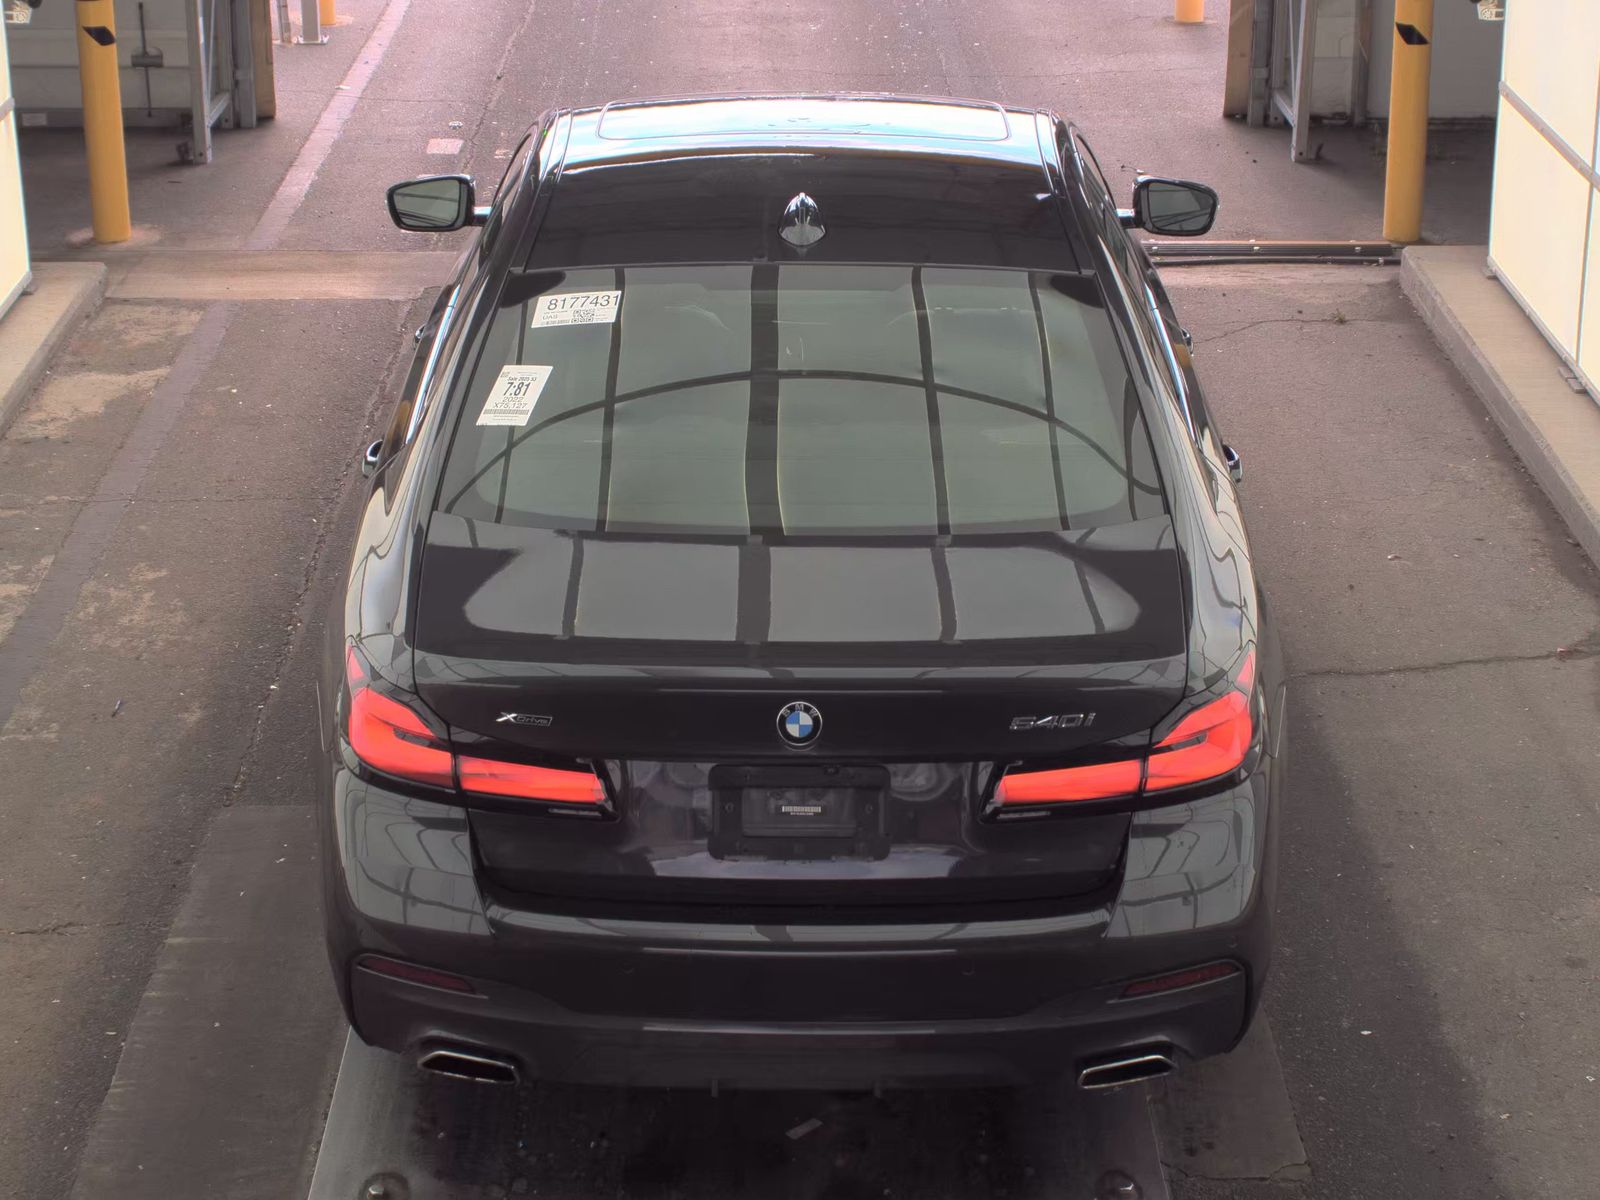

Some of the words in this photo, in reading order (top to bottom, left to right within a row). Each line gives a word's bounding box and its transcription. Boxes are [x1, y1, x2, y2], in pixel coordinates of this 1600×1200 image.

[547, 294, 620, 311] 8177431
[503, 382, 531, 396] 7:81
[1009, 712, 1097, 730] 540i
